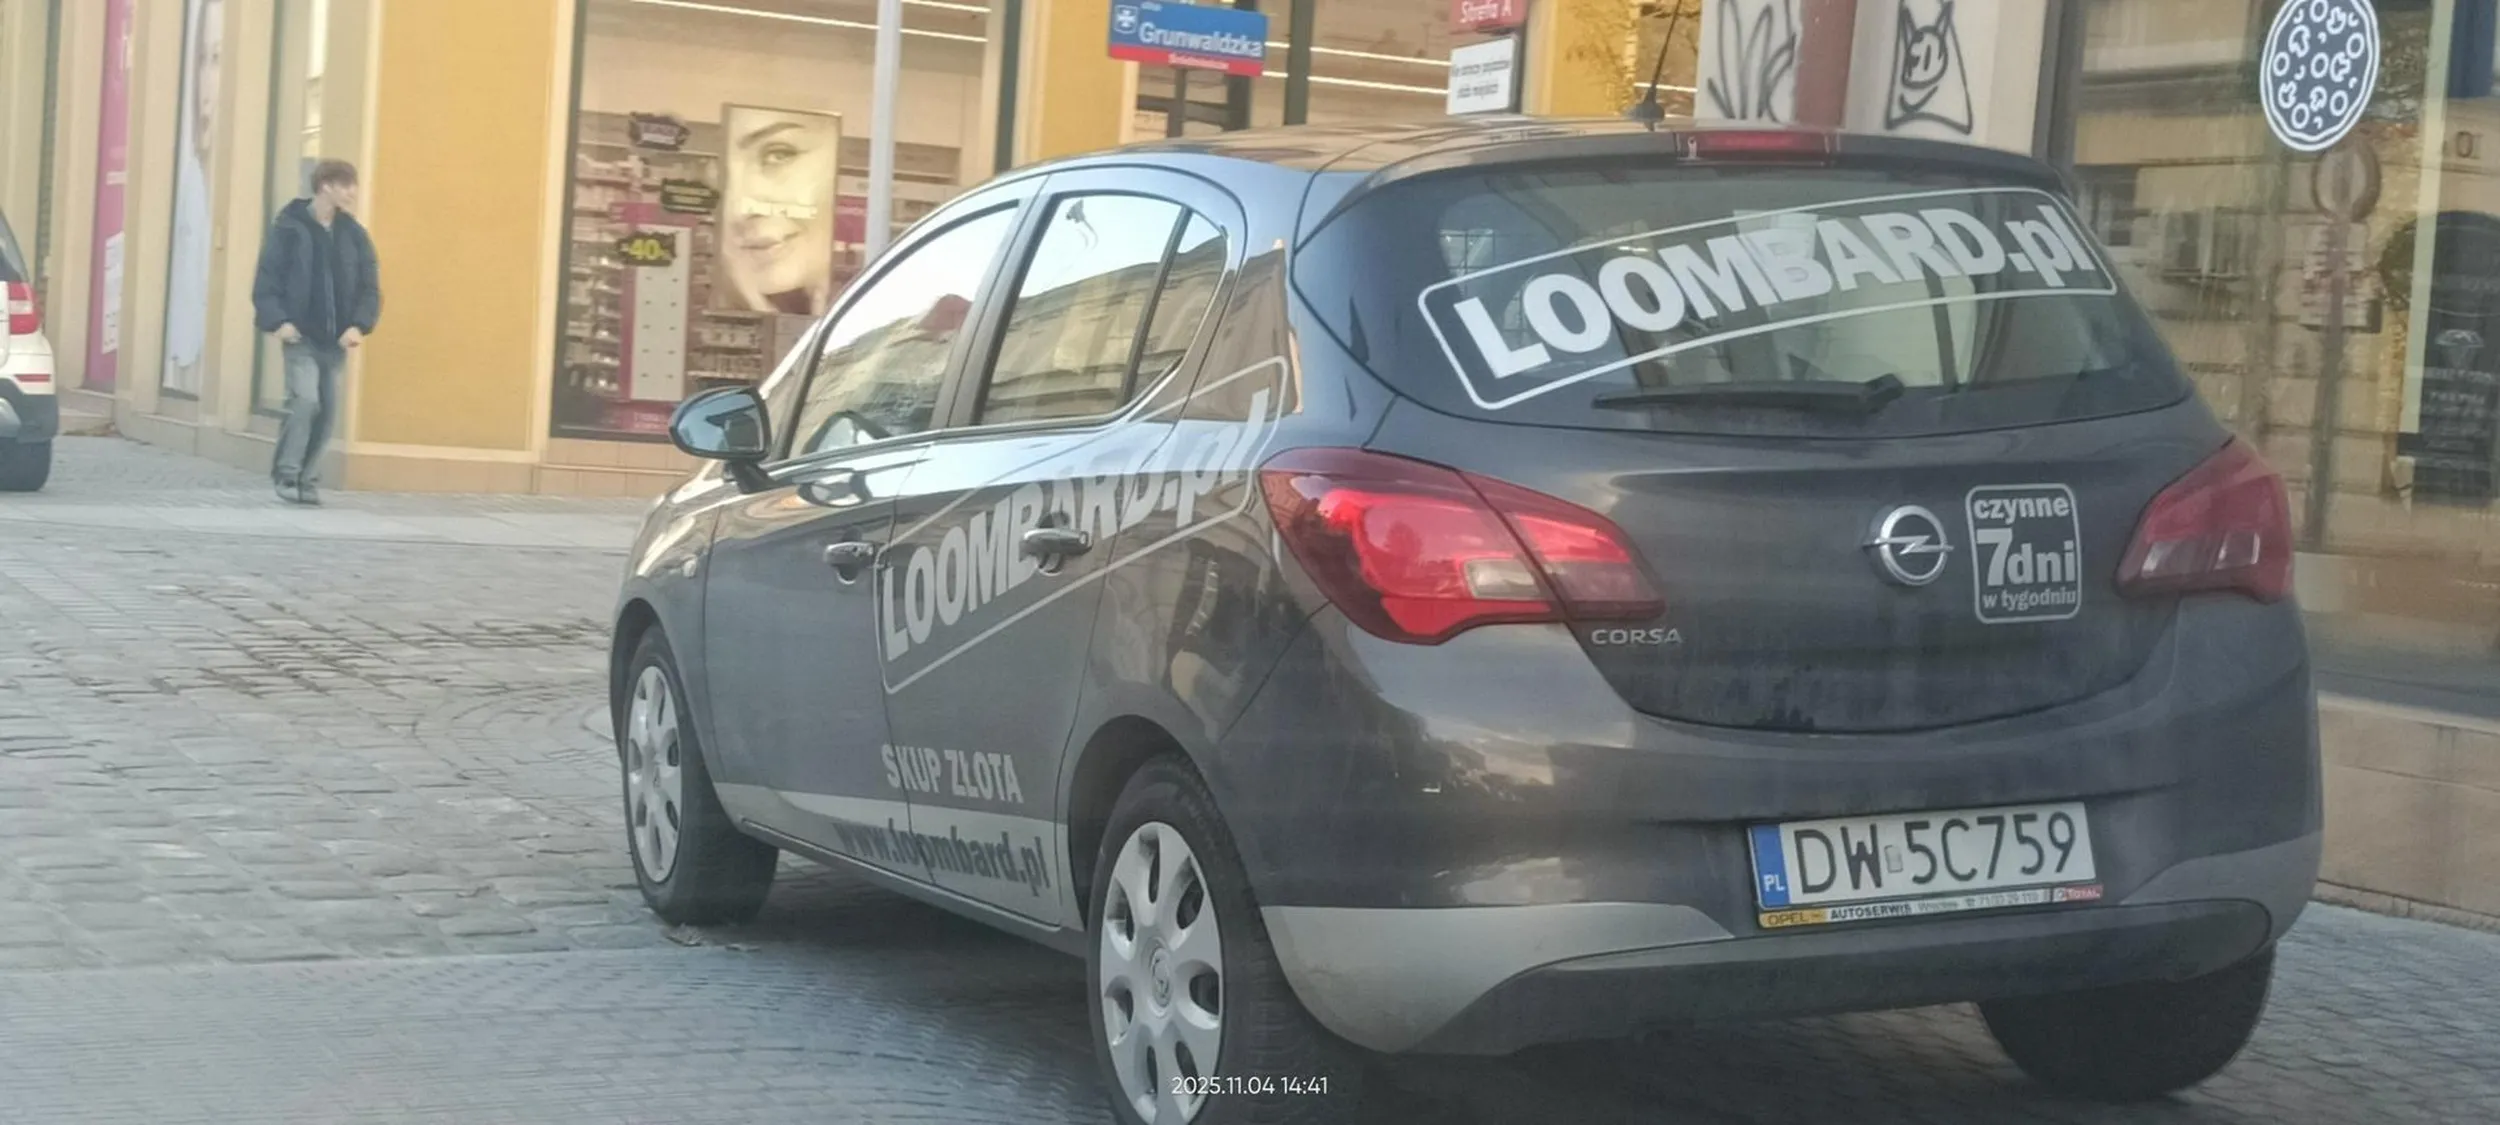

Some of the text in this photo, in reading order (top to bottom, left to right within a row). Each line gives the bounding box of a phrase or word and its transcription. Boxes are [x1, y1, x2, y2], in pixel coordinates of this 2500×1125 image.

[1139, 22, 1263, 57] Grunwaldzka
[1453, 205, 2096, 379] LOOMBARD.pl
[882, 387, 1271, 662] LOOMBARD.pl
[1973, 495, 2070, 524] czynne
[1983, 588, 2077, 612] w tygodniu
[1591, 627, 1684, 646] CORSA
[881, 743, 1024, 804] SKUP ZŁOTA
[832, 817, 1050, 898] www.loombard.pl
[1794, 811, 2076, 894] DW 5C759
[1763, 874, 1786, 893] PL
[1767, 913, 1810, 926] OPEL
[1830, 903, 1912, 919] AUTOSERWIS
